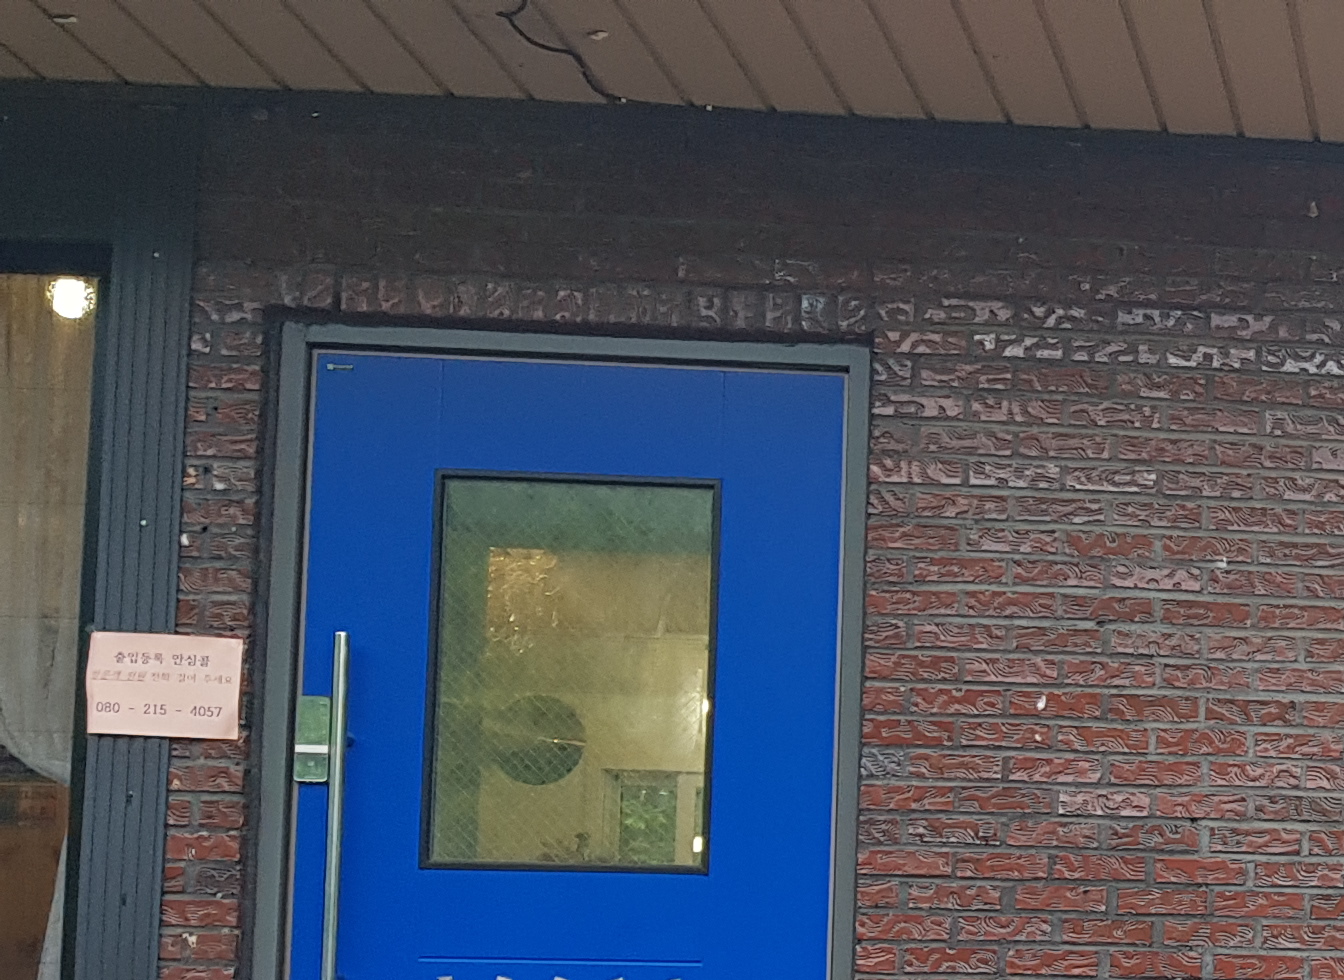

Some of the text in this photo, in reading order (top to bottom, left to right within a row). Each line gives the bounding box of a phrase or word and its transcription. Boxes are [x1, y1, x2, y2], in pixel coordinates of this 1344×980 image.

[172, 653, 210, 668] 안심콜
[96, 701, 120, 714] 080
[143, 703, 167, 715] 215
